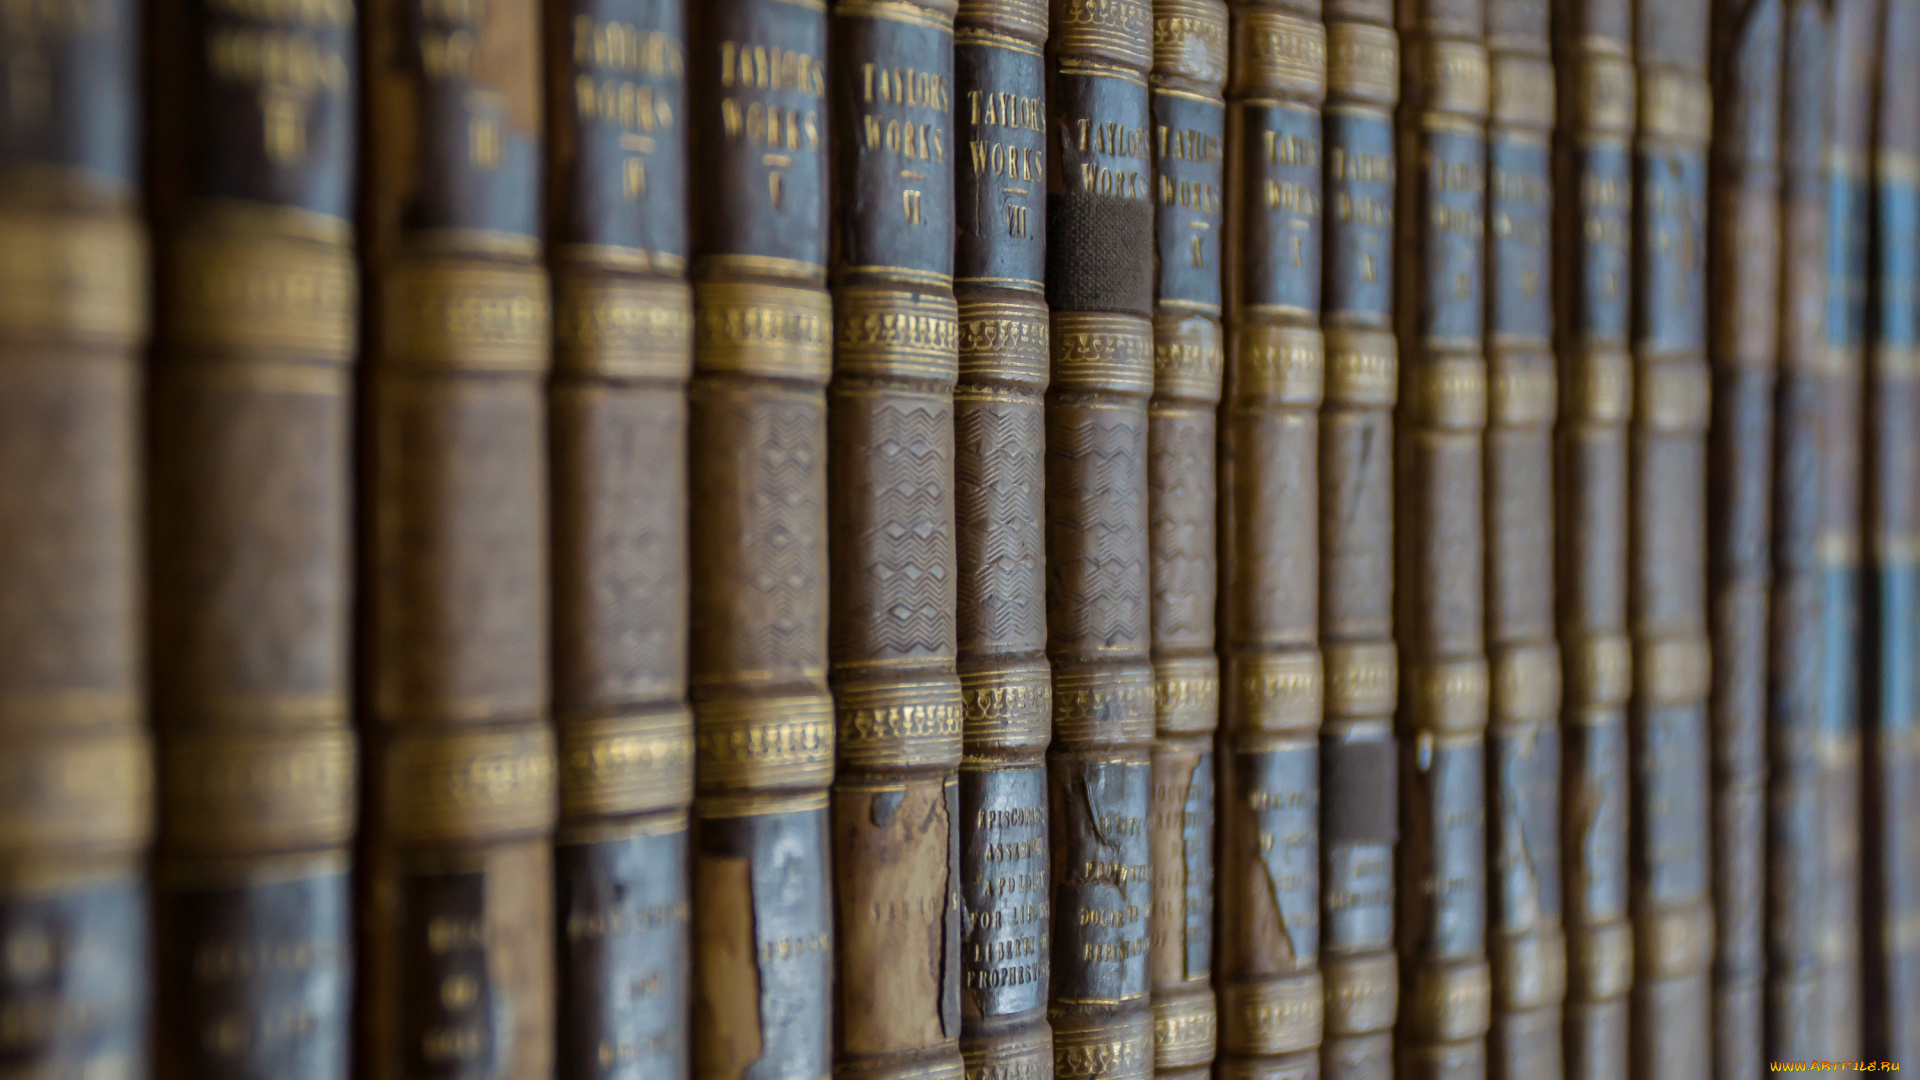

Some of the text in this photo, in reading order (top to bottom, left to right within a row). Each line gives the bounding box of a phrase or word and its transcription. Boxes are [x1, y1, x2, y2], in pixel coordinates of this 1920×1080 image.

[721, 97, 819, 151] WORKS
[967, 89, 1046, 134] TAYLOR'S
[864, 114, 943, 163] WORKS
[968, 139, 1043, 183] WORKS
[1081, 162, 1147, 199] WORKS
[1159, 174, 1220, 216] WORKS
[970, 907, 1003, 930] FOR
[974, 934, 1036, 963] LIBERTY
